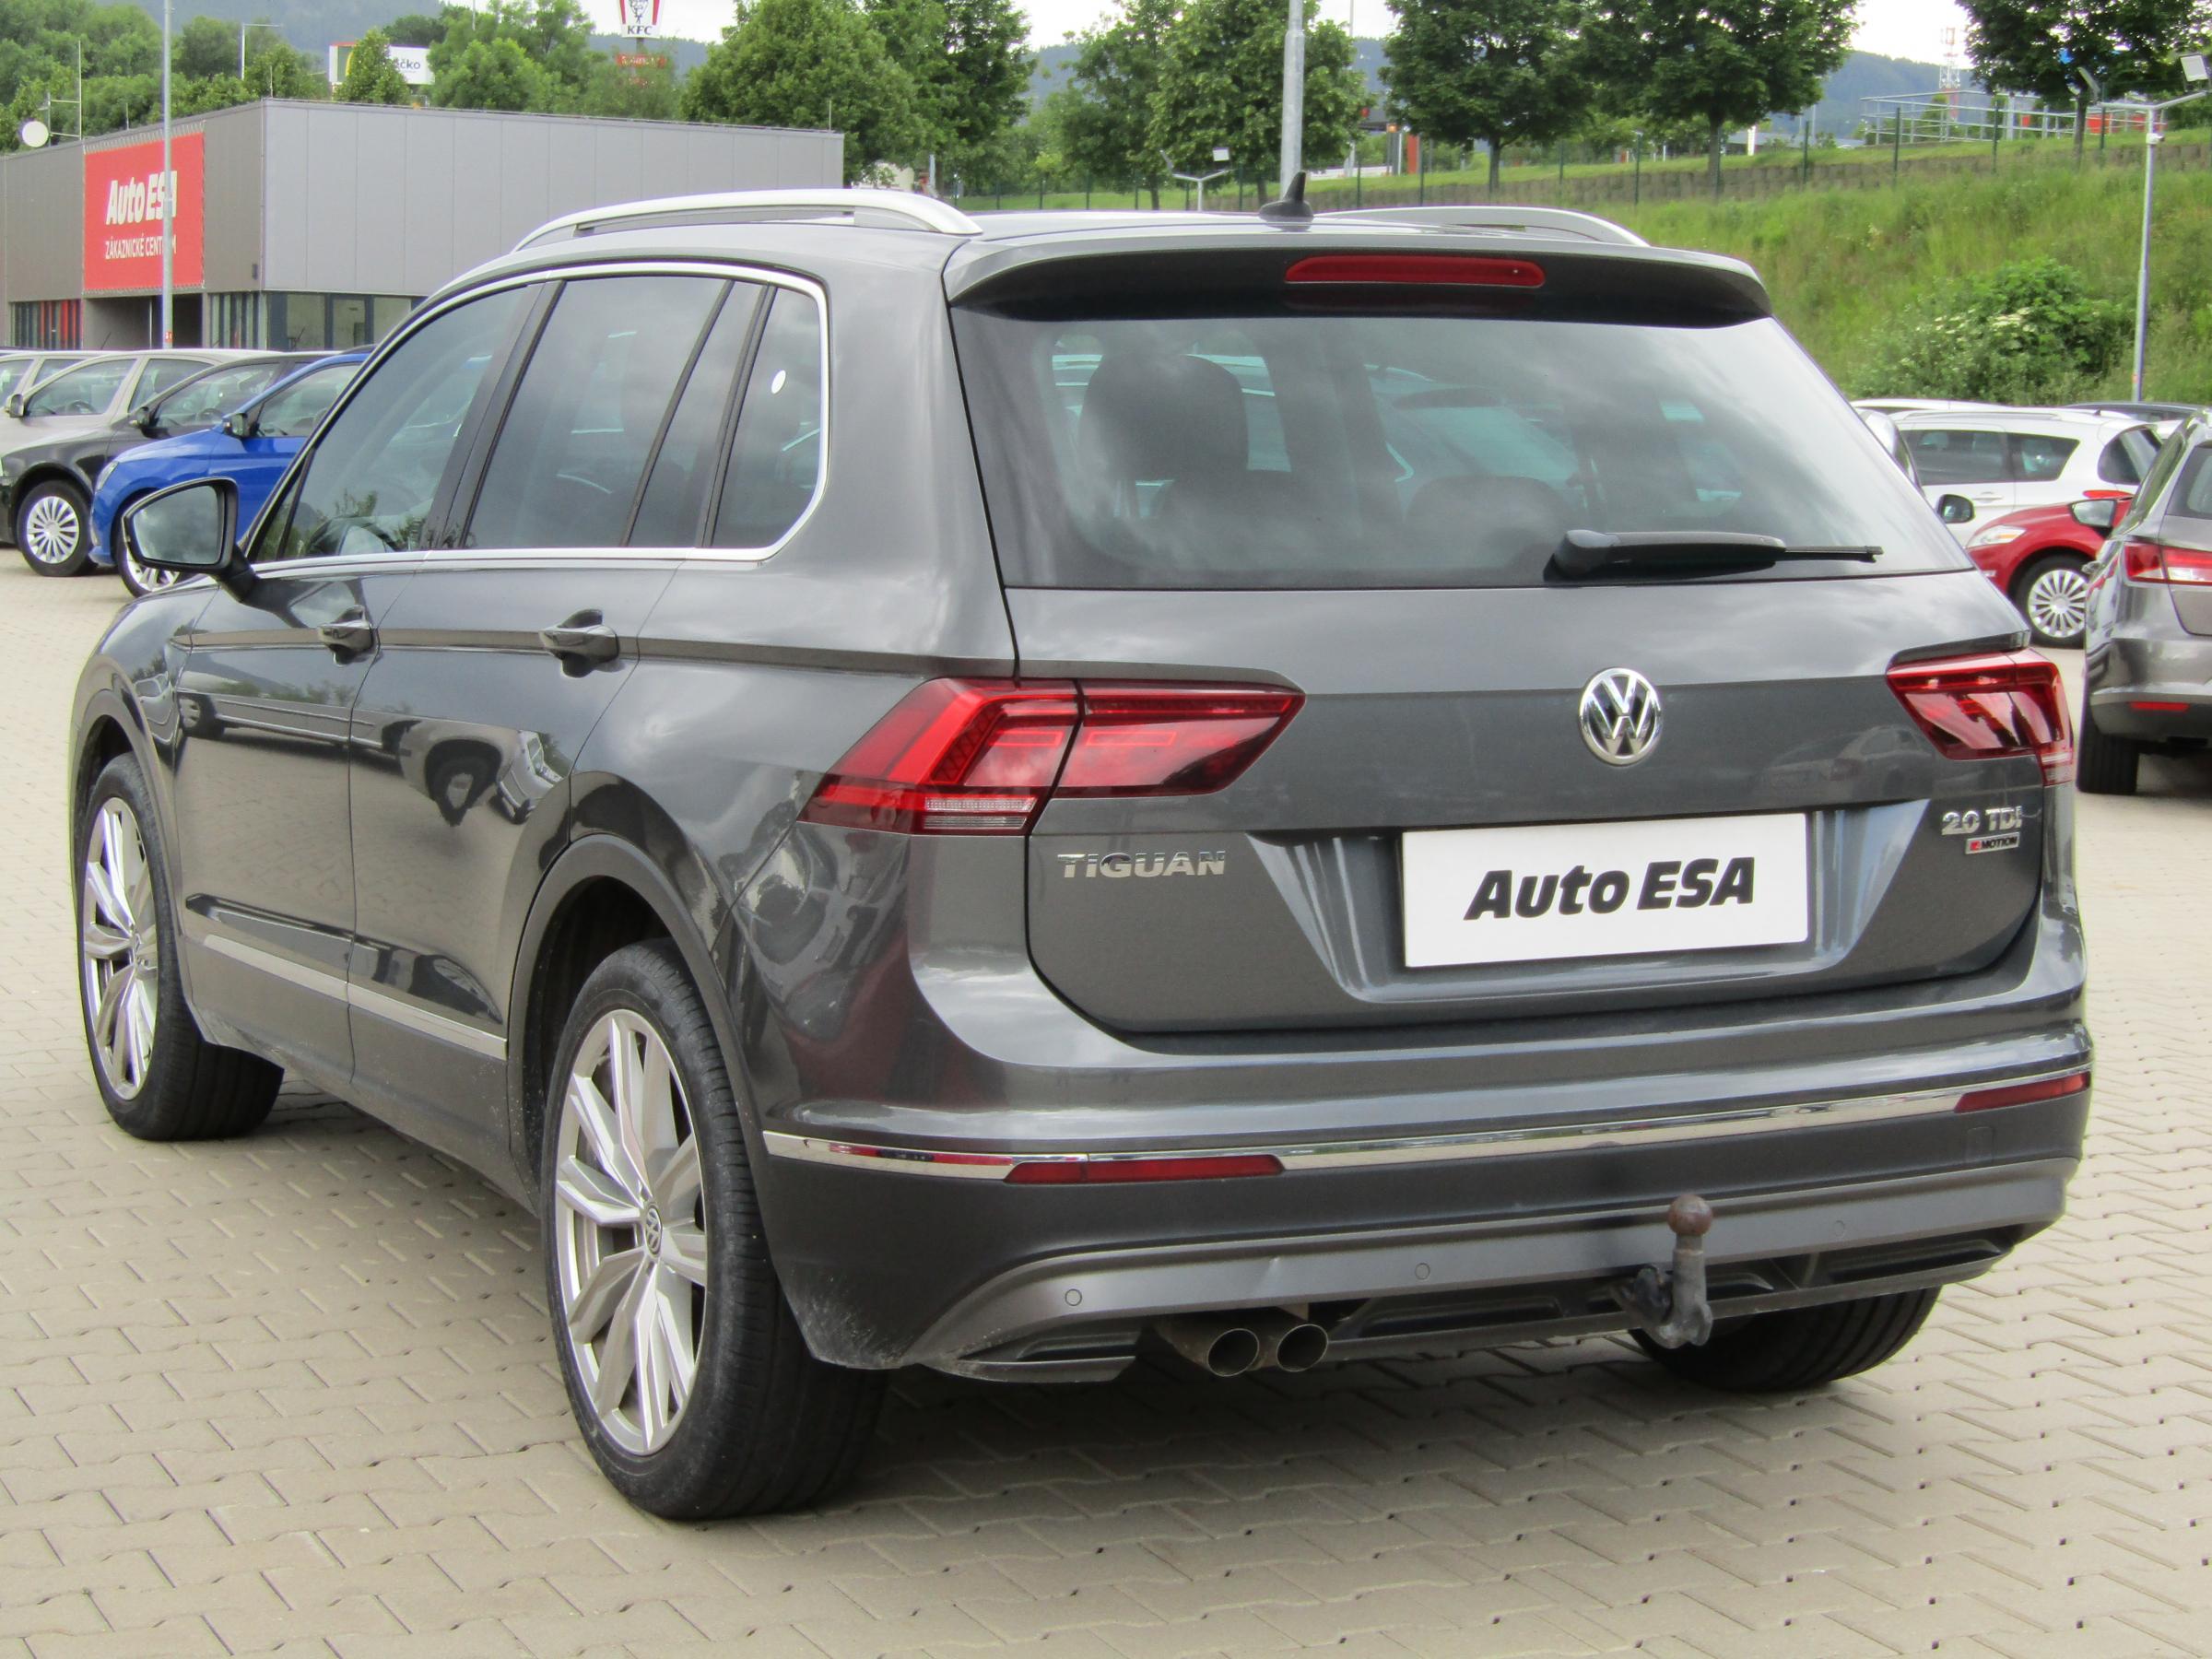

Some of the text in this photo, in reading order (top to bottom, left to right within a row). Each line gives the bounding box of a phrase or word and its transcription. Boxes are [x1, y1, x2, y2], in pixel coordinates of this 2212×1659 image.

[628, 26, 653, 35] KFC
[106, 177, 145, 225] Auto
[105, 233, 177, 260] ZÁKAZNICKÉ CENTM
[1464, 856, 1755, 920] Auto ESA
